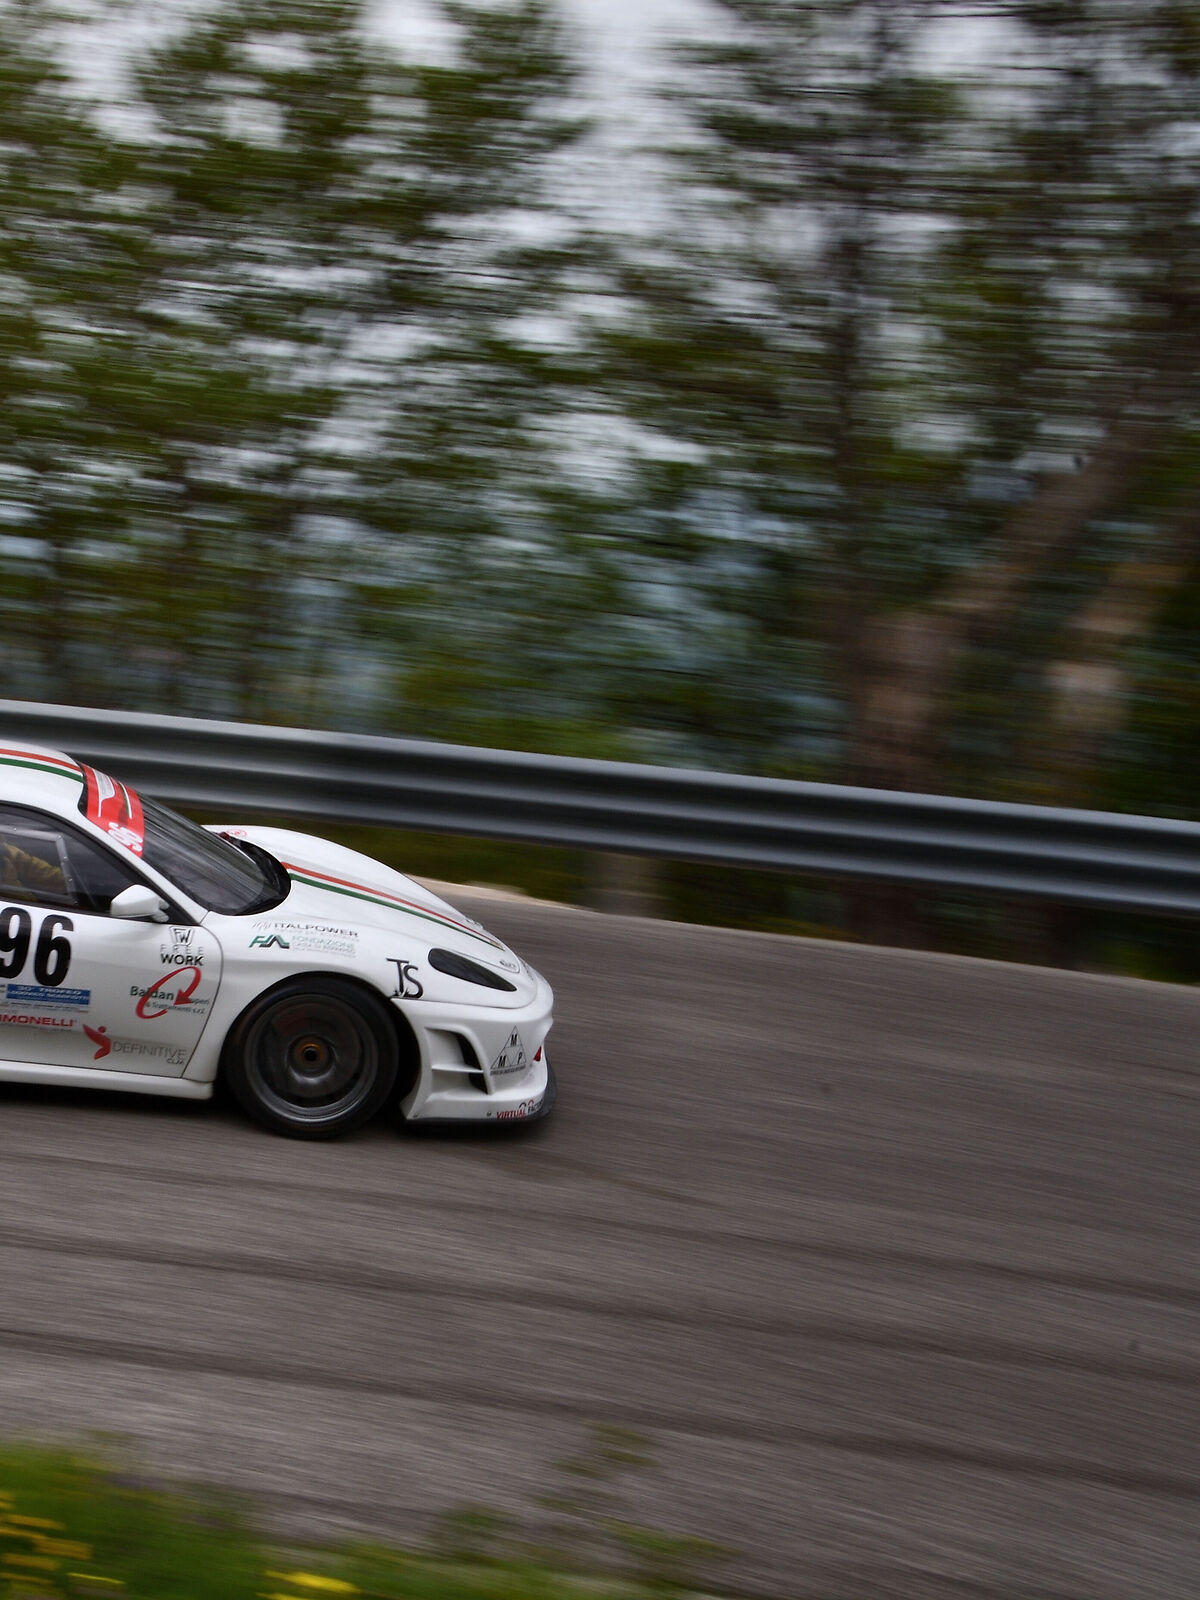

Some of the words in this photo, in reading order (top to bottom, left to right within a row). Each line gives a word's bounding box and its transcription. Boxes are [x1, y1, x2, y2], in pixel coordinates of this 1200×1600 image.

[274, 923, 359, 937] ITALPOWER
[160, 944, 204, 955] FREE
[161, 953, 204, 966] WORK
[510, 1033, 518, 1046] M
[111, 1041, 187, 1058] DEFINITIVE
[498, 1054, 507, 1068] M
[517, 1052, 523, 1065] P
[496, 1109, 526, 1119] VIRTUAL
